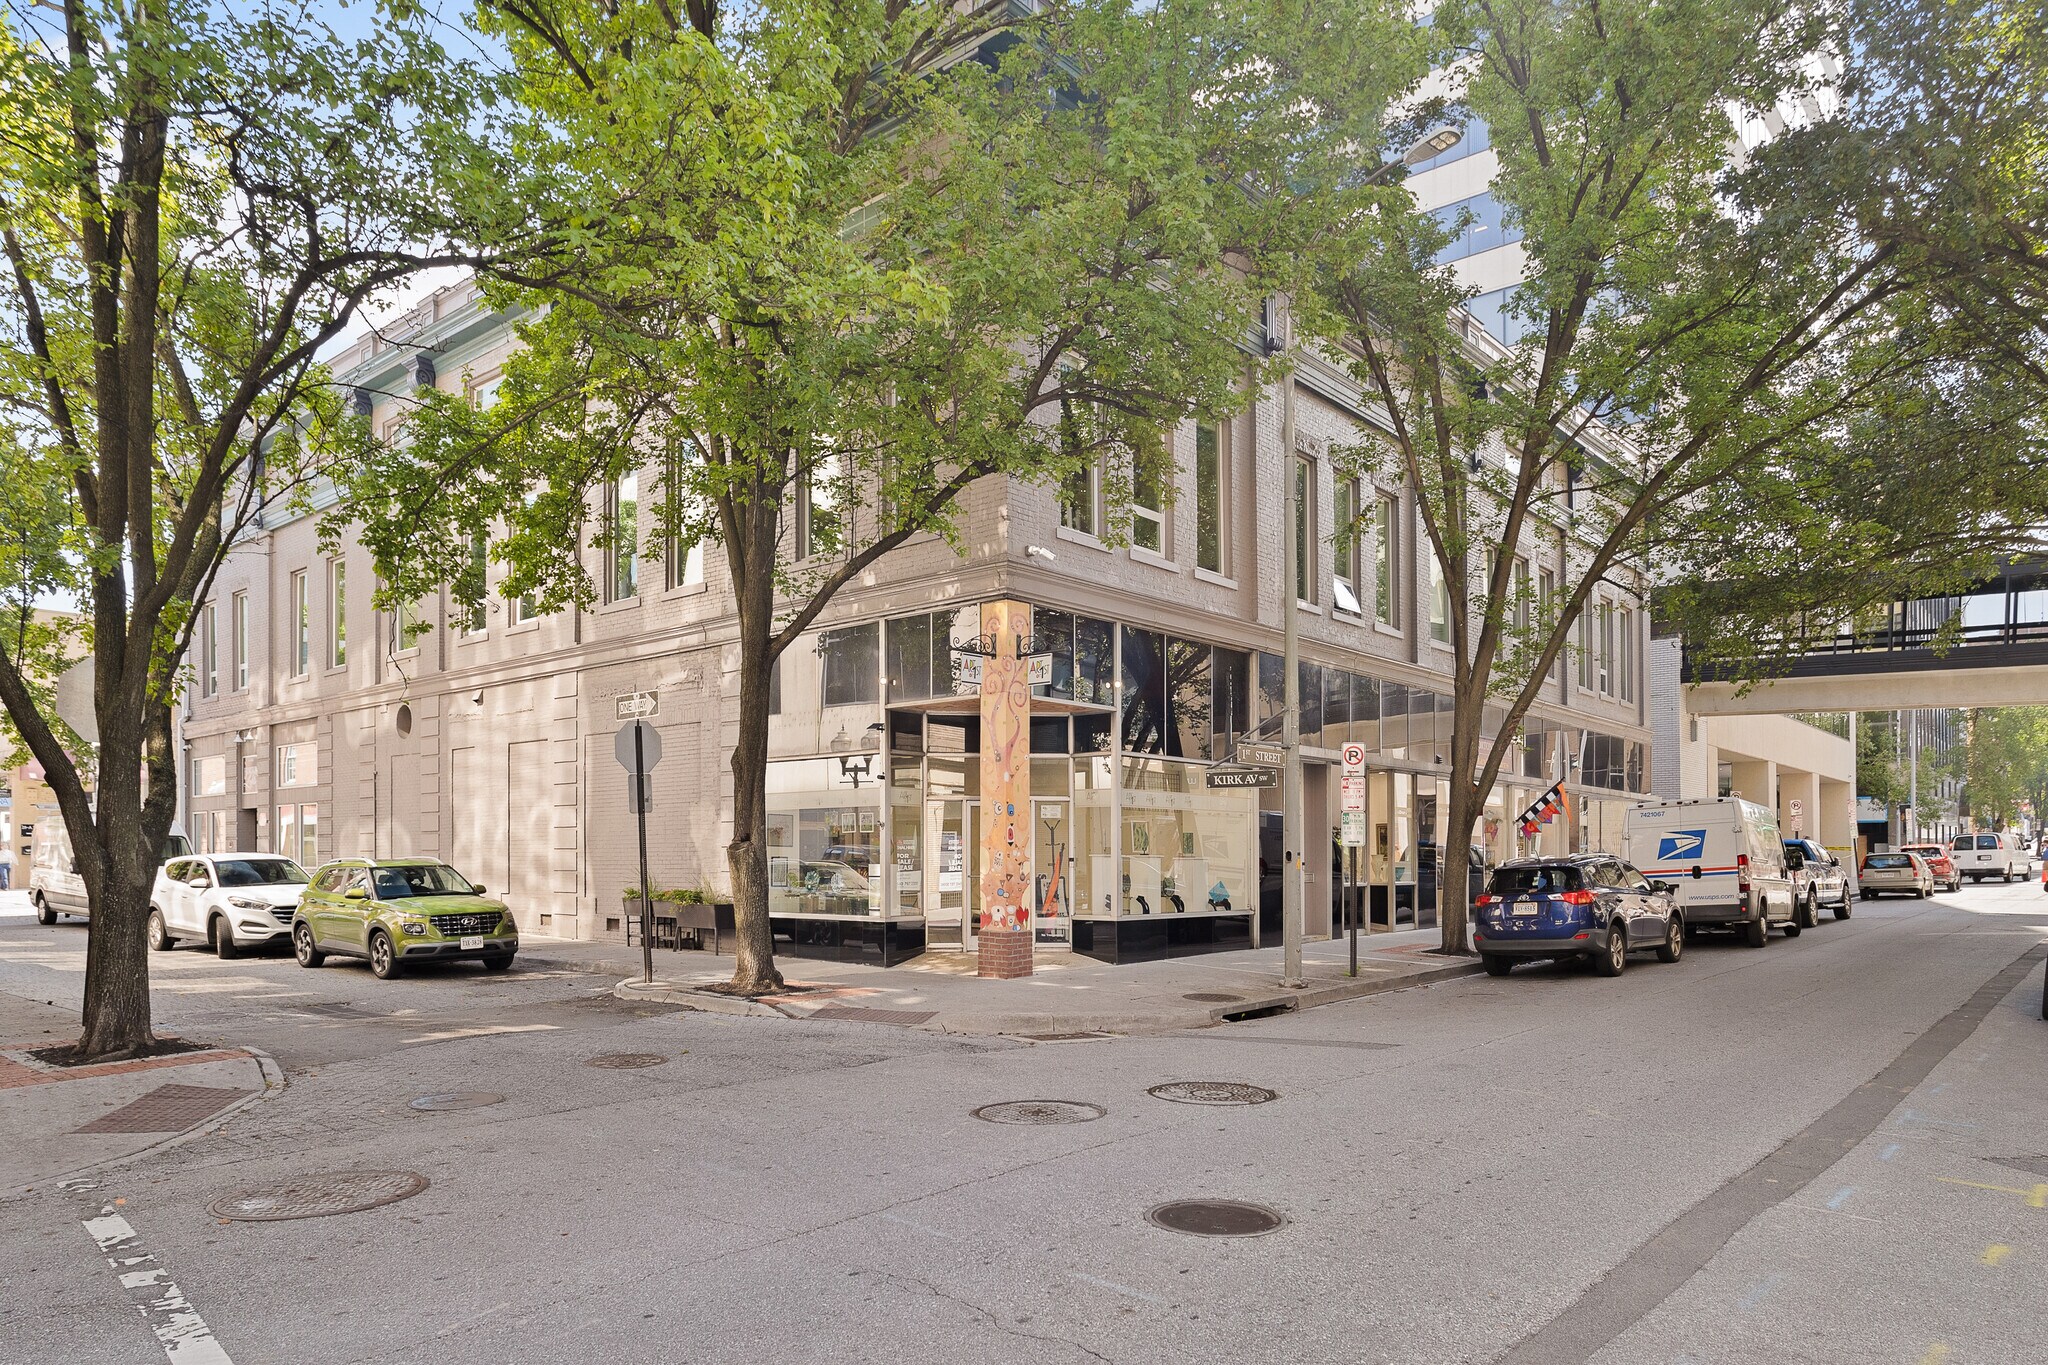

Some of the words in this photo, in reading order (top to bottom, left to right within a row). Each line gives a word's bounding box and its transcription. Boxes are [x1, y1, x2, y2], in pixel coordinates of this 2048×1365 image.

[620, 701, 632, 713] ONE
[633, 699, 647, 711] WAY
[1242, 749, 1251, 760] 1ST
[1255, 750, 1282, 764] STREET
[1213, 774, 1243, 785] KIRK
[1244, 774, 1259, 785] AV
[1689, 893, 1735, 901] www.usps.com
